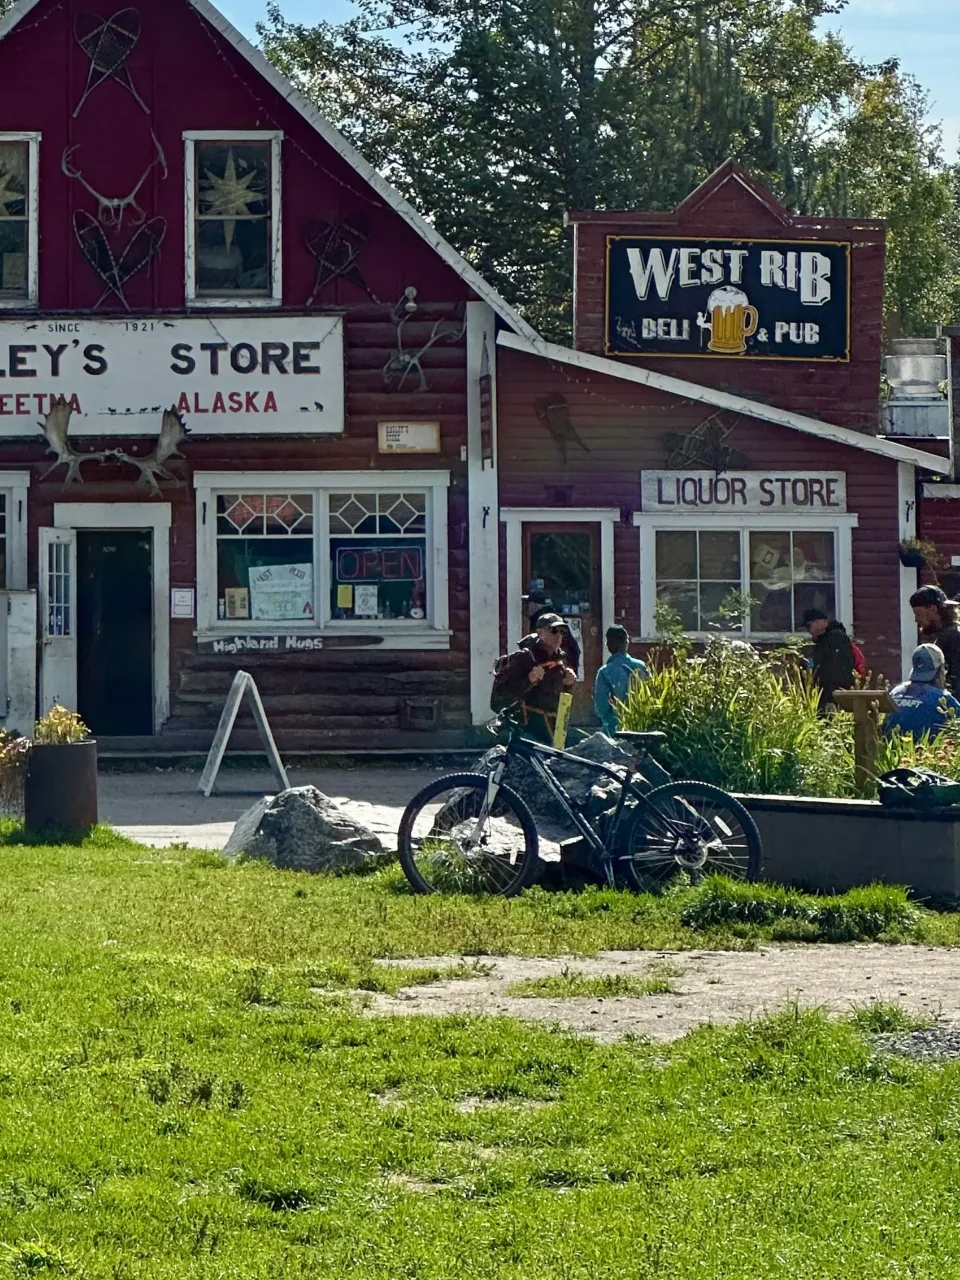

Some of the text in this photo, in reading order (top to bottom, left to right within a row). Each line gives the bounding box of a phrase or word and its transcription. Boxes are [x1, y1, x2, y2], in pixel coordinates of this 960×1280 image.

[626, 247, 831, 306] WEST RIB
[48, 322, 154, 333] SINCE 1921
[642, 317, 820, 344] DELI & PUB
[170, 341, 321, 376] STORE
[177, 391, 278, 413] ALASKA
[657, 477, 841, 507] LIQUOR STORE
[339, 550, 421, 579] OPEN
[213, 635, 324, 654] Highland Hugs
